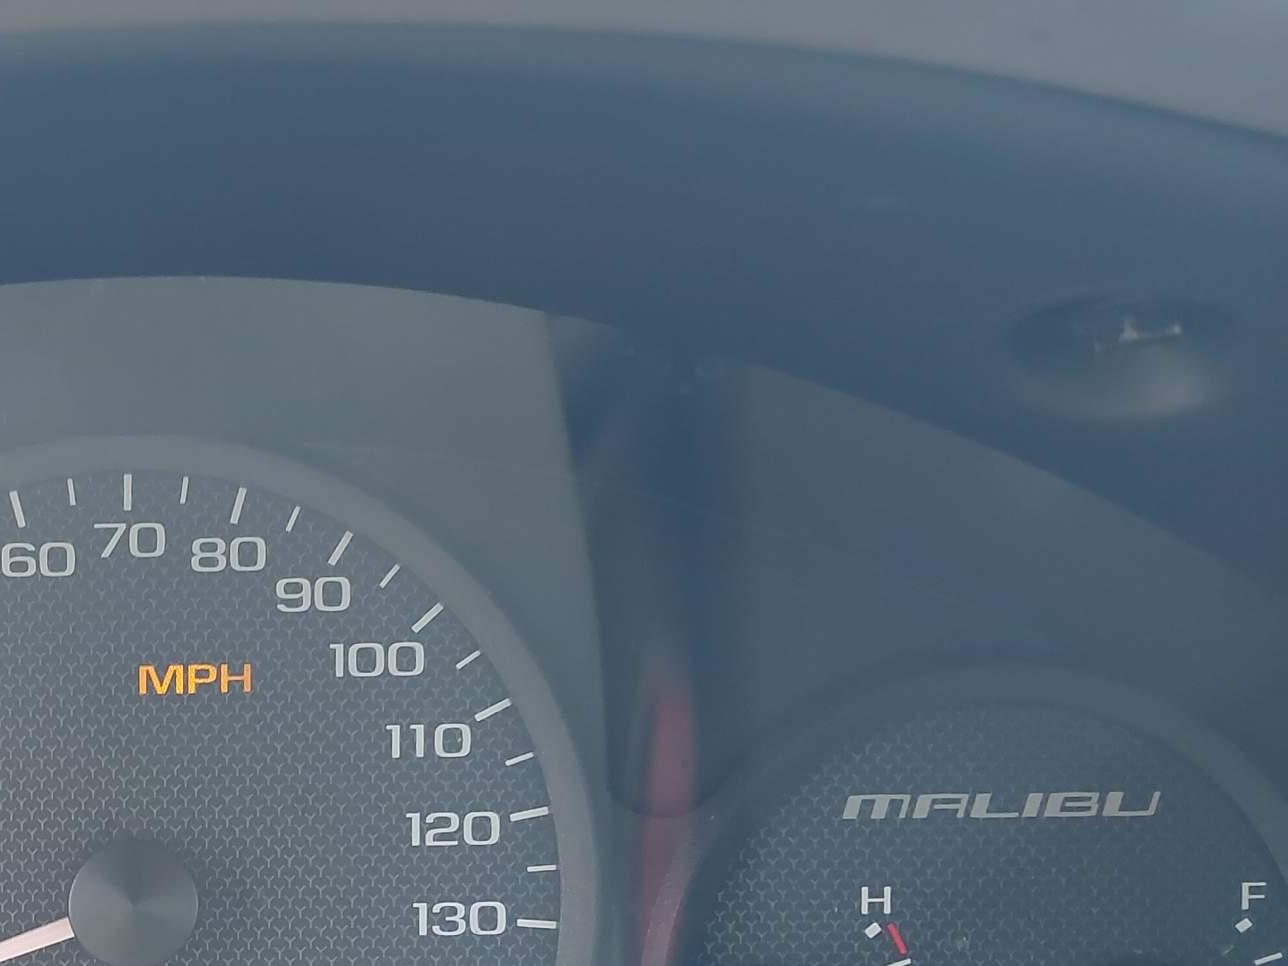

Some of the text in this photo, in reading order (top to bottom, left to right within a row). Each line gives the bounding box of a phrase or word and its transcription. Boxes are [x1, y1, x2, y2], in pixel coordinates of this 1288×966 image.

[93, 522, 166, 559] 70
[191, 537, 267, 573] 80
[1, 542, 76, 577] 60
[276, 577, 351, 613] 90
[329, 641, 425, 677] 100
[138, 663, 253, 695] MPH
[385, 723, 472, 759] 110
[842, 791, 1161, 820] MALIBU
[405, 812, 501, 846] 120
[861, 886, 892, 914] H
[1241, 881, 1267, 910] F
[412, 901, 507, 936] 130
